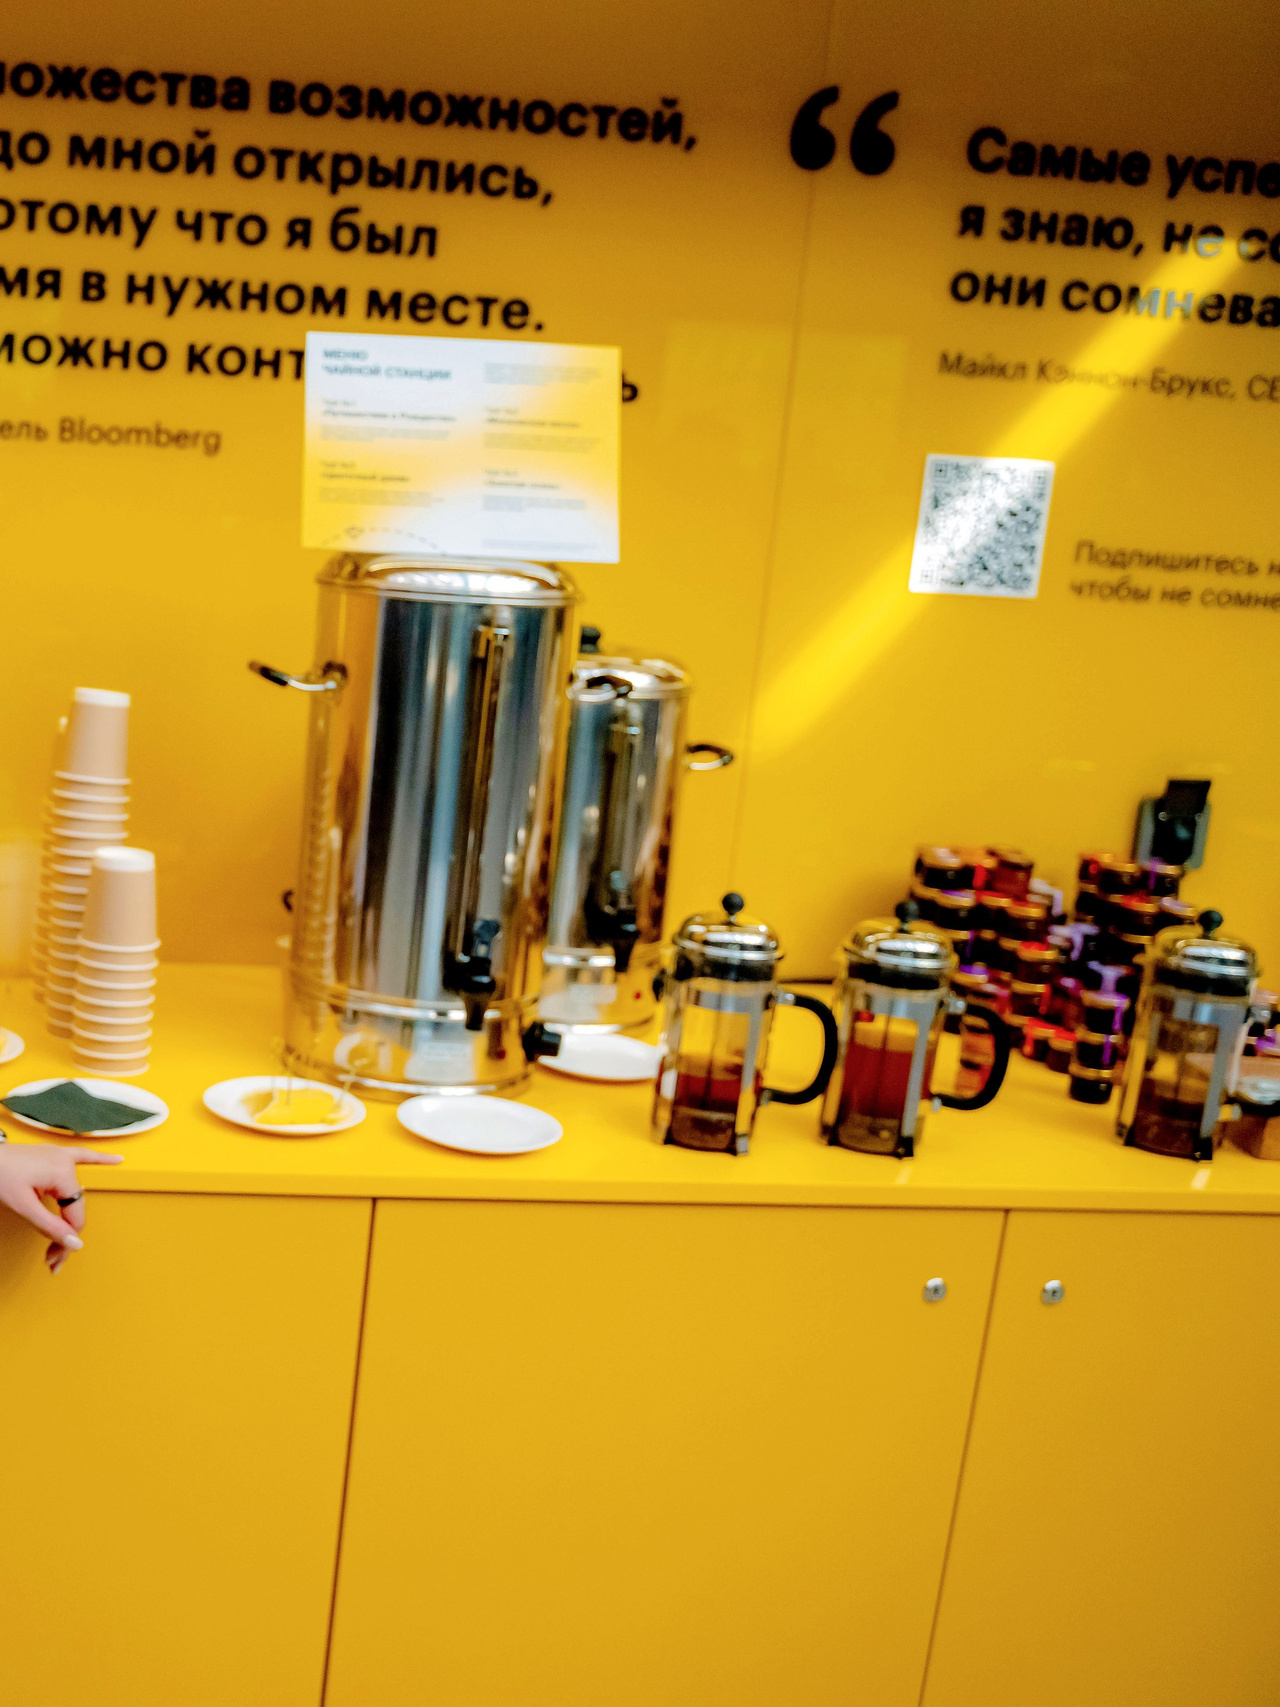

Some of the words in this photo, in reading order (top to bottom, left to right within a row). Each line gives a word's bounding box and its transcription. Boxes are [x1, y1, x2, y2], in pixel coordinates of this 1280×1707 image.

[268, 79, 696, 150] возможностей,
[69, 130, 216, 176] мной
[233, 145, 552, 208] открылись,
[967, 126, 1151, 187] Самые
[176, 210, 268, 246] что
[286, 217, 312, 248] я
[330, 206, 437, 257] был
[959, 205, 985, 237] я
[1000, 207, 1143, 256] знаю,
[1163, 221, 1226, 259] не
[81, 271, 106, 302] в
[126, 274, 347, 317] нужном
[366, 289, 543, 331] месте.
[950, 271, 1046, 308] они
[939, 351, 1026, 379] Майкл
[58, 416, 222, 457] Bloomberg
[1073, 539, 1260, 577] Подпишитесь
[1070, 575, 1152, 604] чтобы
[1161, 588, 1192, 605] не
